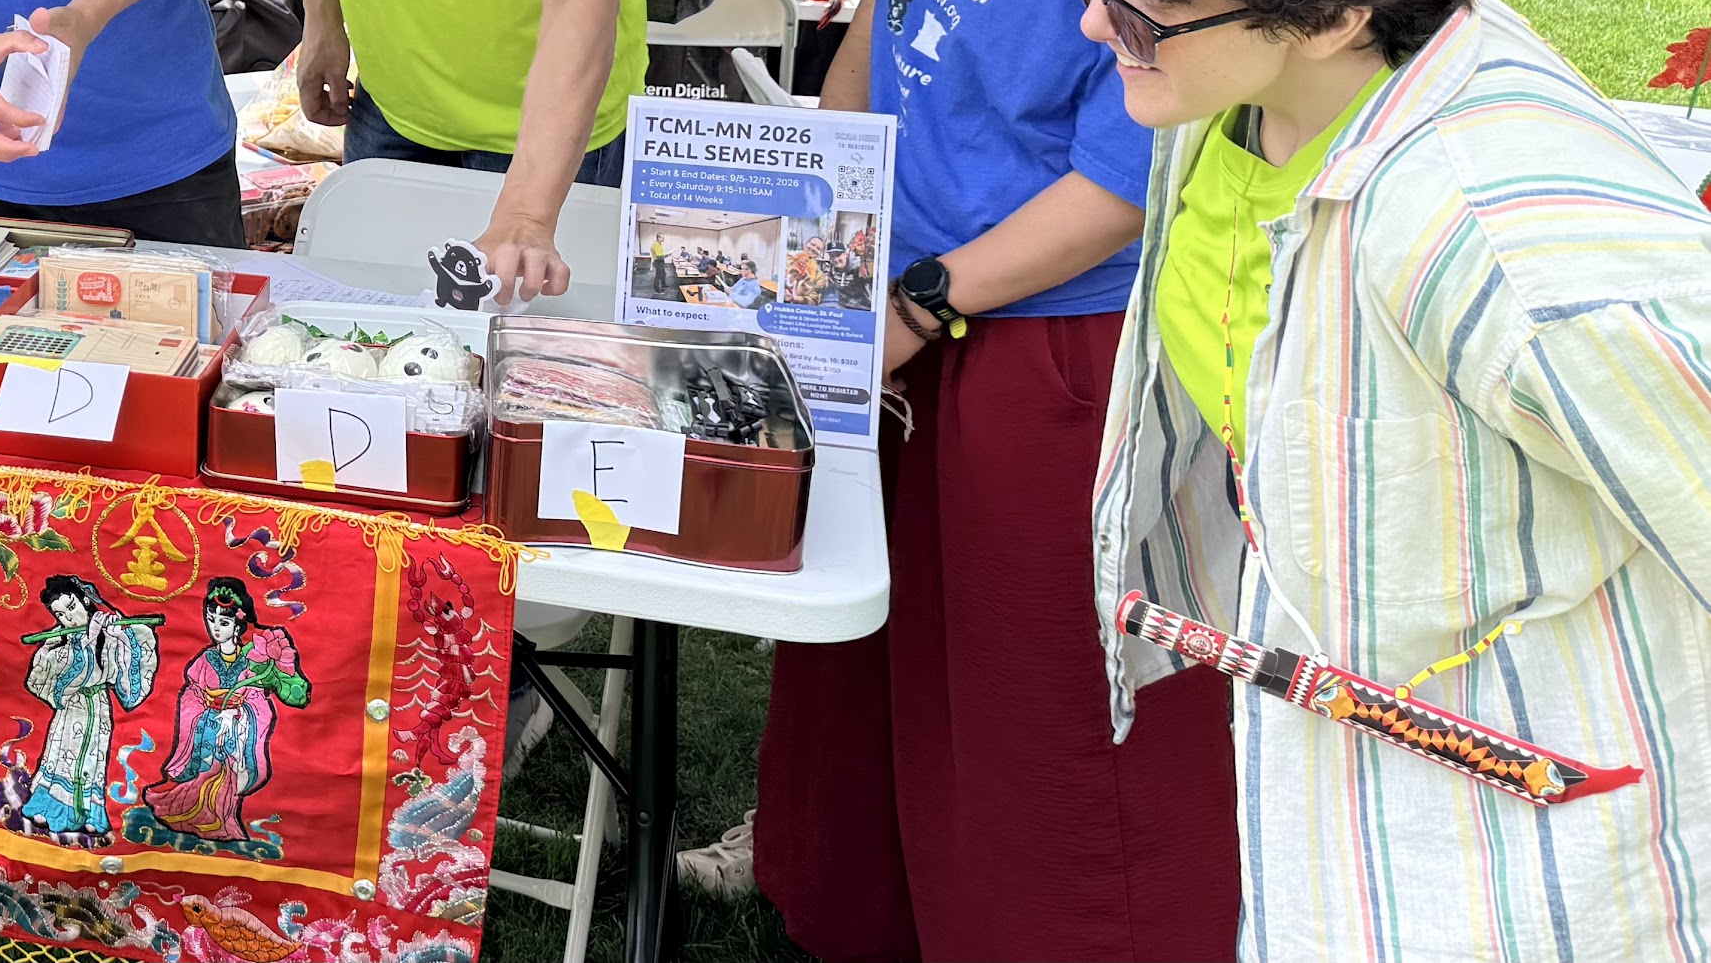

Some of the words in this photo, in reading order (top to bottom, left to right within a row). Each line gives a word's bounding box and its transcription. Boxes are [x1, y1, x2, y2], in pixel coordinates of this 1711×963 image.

[675, 83, 728, 100] Digital.
[646, 116, 752, 139] TCML-MN
[759, 124, 812, 144] 2026
[644, 140, 698, 160] FALL
[704, 145, 824, 170] SEMESTER
[649, 179, 674, 192] Every
[675, 181, 714, 194] Saturday
[716, 184, 773, 197] 9:15-11:15AM
[650, 167, 672, 179] Start
[673, 169, 680, 178] &
[681, 169, 698, 180] End
[700, 171, 728, 183] Dates:
[730, 174, 774, 187] 9/5-12/12,
[776, 177, 799, 188] 2026
[649, 191, 670, 202] Total
[671, 192, 680, 202] of
[682, 193, 692, 202] 14
[694, 194, 724, 206] Weeks
[635, 306, 661, 316] What
[663, 308, 673, 317] to
[674, 309, 710, 321] expect:
[774, 306, 795, 314] Hubbs
[796, 308, 818, 316] Center,
[813, 355, 829, 364] Aug.
[48, 367, 93, 423] D
[328, 408, 372, 473] D
[591, 440, 628, 503] E
[110, 506, 188, 591] 金
